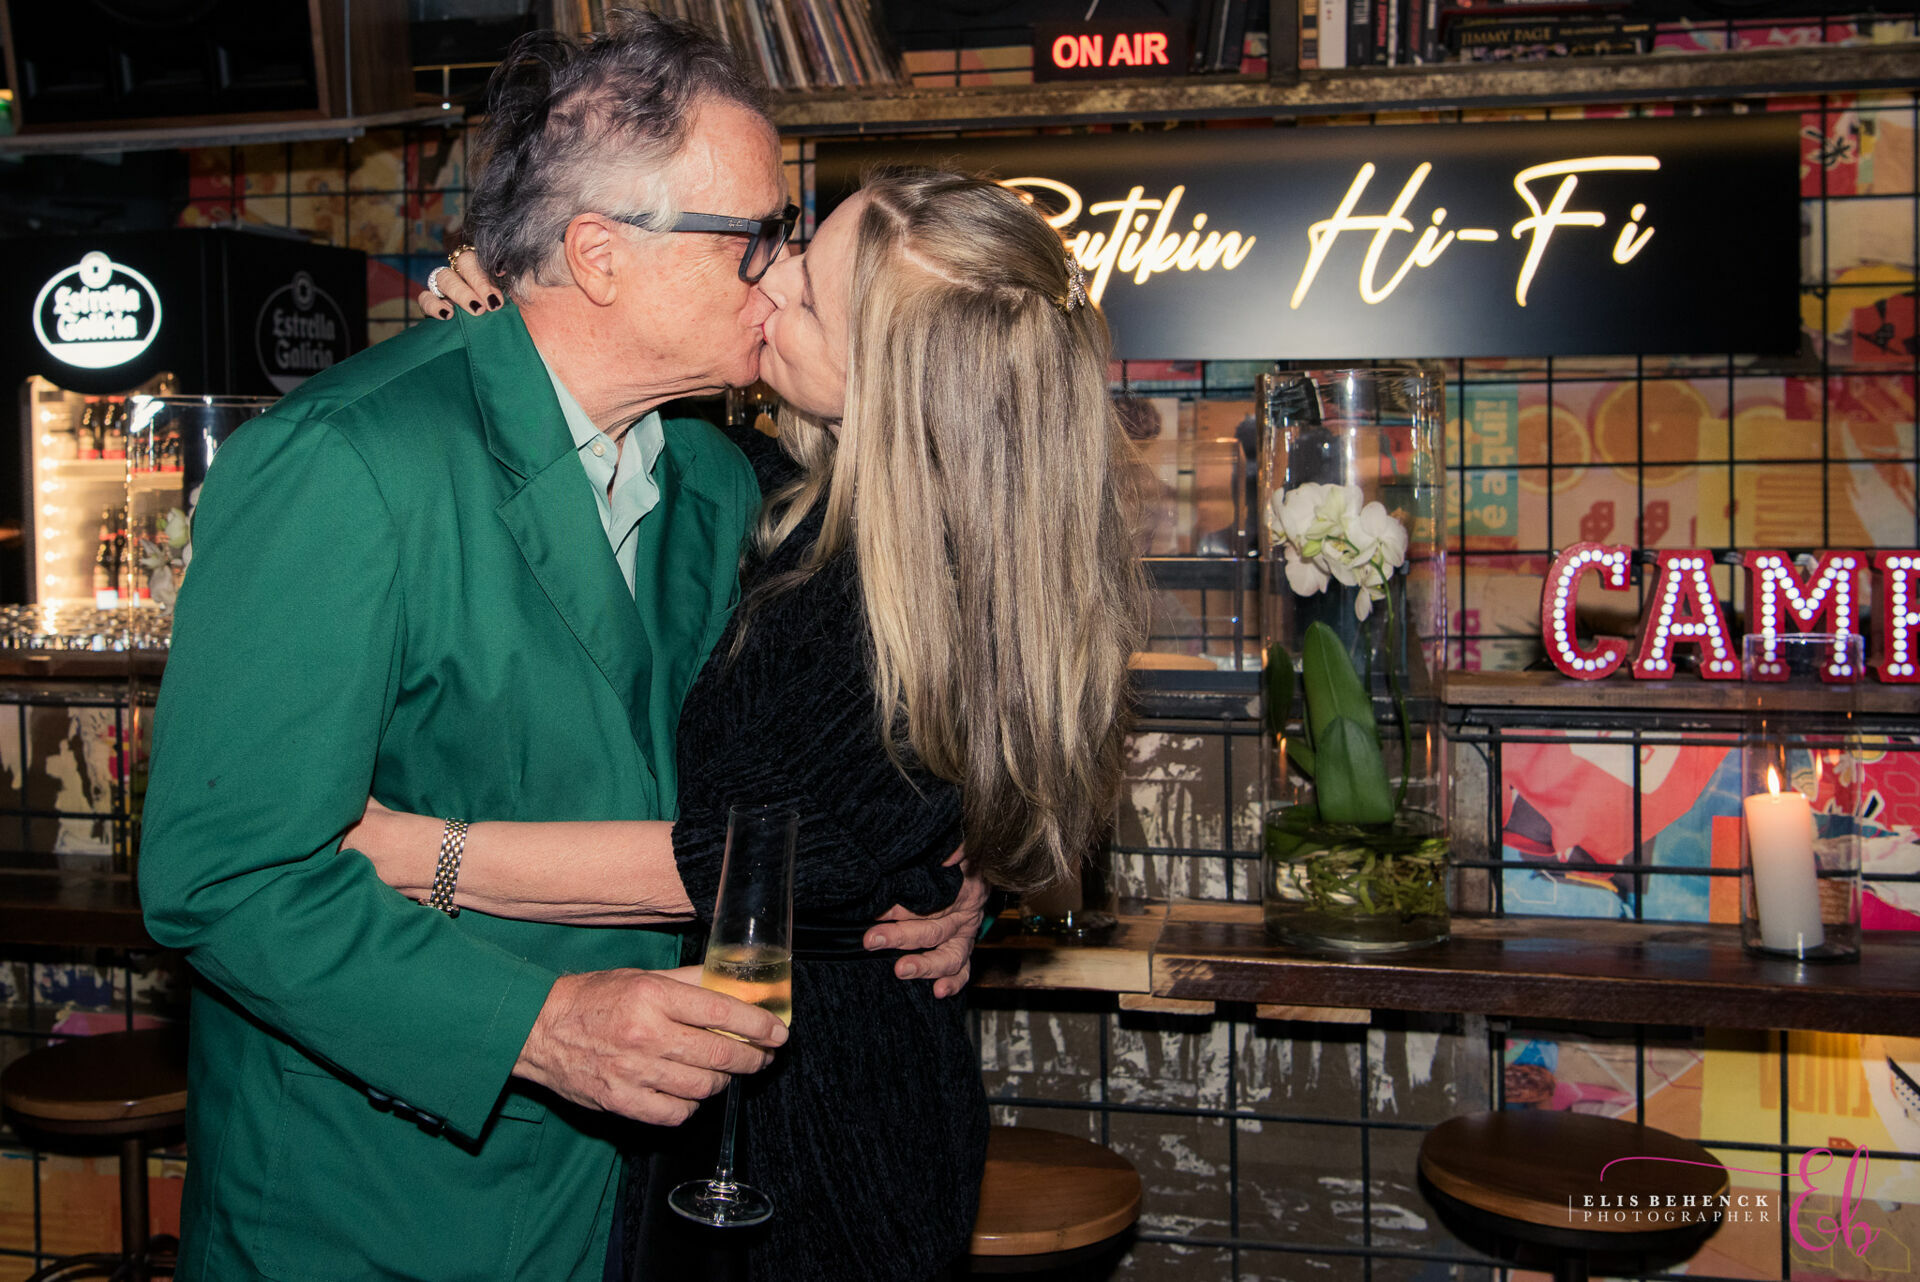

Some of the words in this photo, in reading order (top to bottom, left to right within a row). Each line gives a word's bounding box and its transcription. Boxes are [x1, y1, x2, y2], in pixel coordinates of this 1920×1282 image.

[1052, 34, 1103, 69] ON
[1108, 32, 1170, 67] AIR
[1461, 30, 1511, 45] JIMMY
[1514, 27, 1551, 42] PAGE
[1289, 155, 1662, 310] Hi-Fi
[272, 307, 336, 341] Estrella
[275, 337, 334, 369] Galicia
[1475, 399, 1514, 496] aqui!
